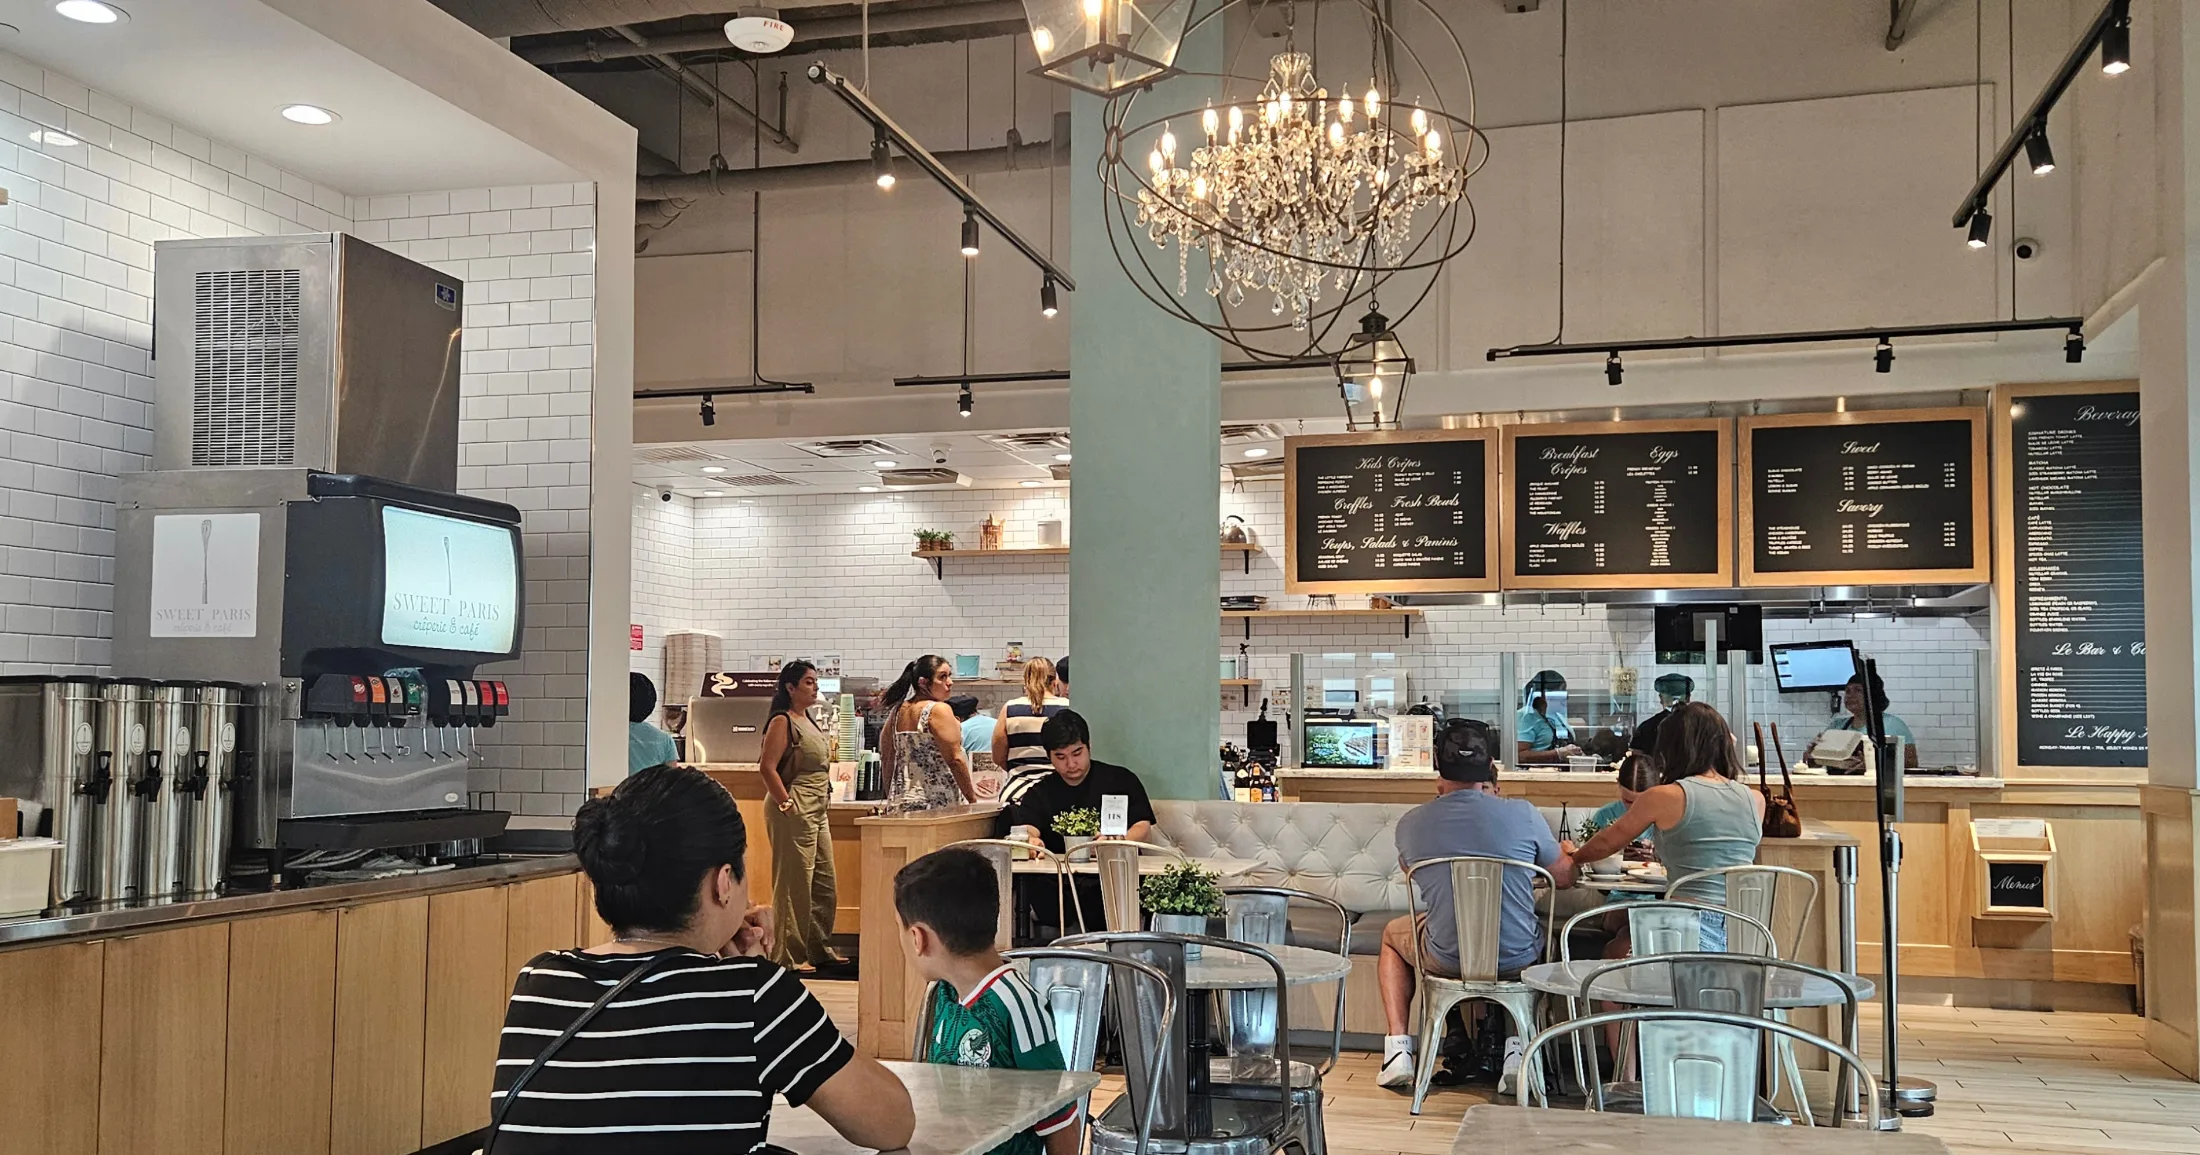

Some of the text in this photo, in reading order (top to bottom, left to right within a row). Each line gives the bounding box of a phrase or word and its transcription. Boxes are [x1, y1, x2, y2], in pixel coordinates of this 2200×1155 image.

[763, 20, 785, 32] FIRE
[1539, 445, 1600, 464] Breakfast
[1649, 445, 1679, 464] Eggs
[1840, 441, 1880, 454] Sweet
[1355, 455, 1382, 470] Kids
[1334, 496, 1373, 514] Croffles
[1390, 492, 1460, 508] Fresh Bowls
[1836, 499, 1884, 518] Savory
[1543, 521, 1588, 540] Waffles
[1360, 535, 1397, 549] Salads
[1414, 535, 1459, 547] Paninis
[155, 608, 252, 621] SWEET PARIS
[393, 592, 500, 621] SWEET PARIS
[413, 616, 447, 635] crêperie
[459, 622, 480, 641] café
[2051, 642, 2073, 656] Le
[2075, 641, 2106, 656] Bar
[2064, 725, 2086, 739] Le
[2087, 725, 2136, 744] Happy
[1993, 875, 2041, 890] Menus
